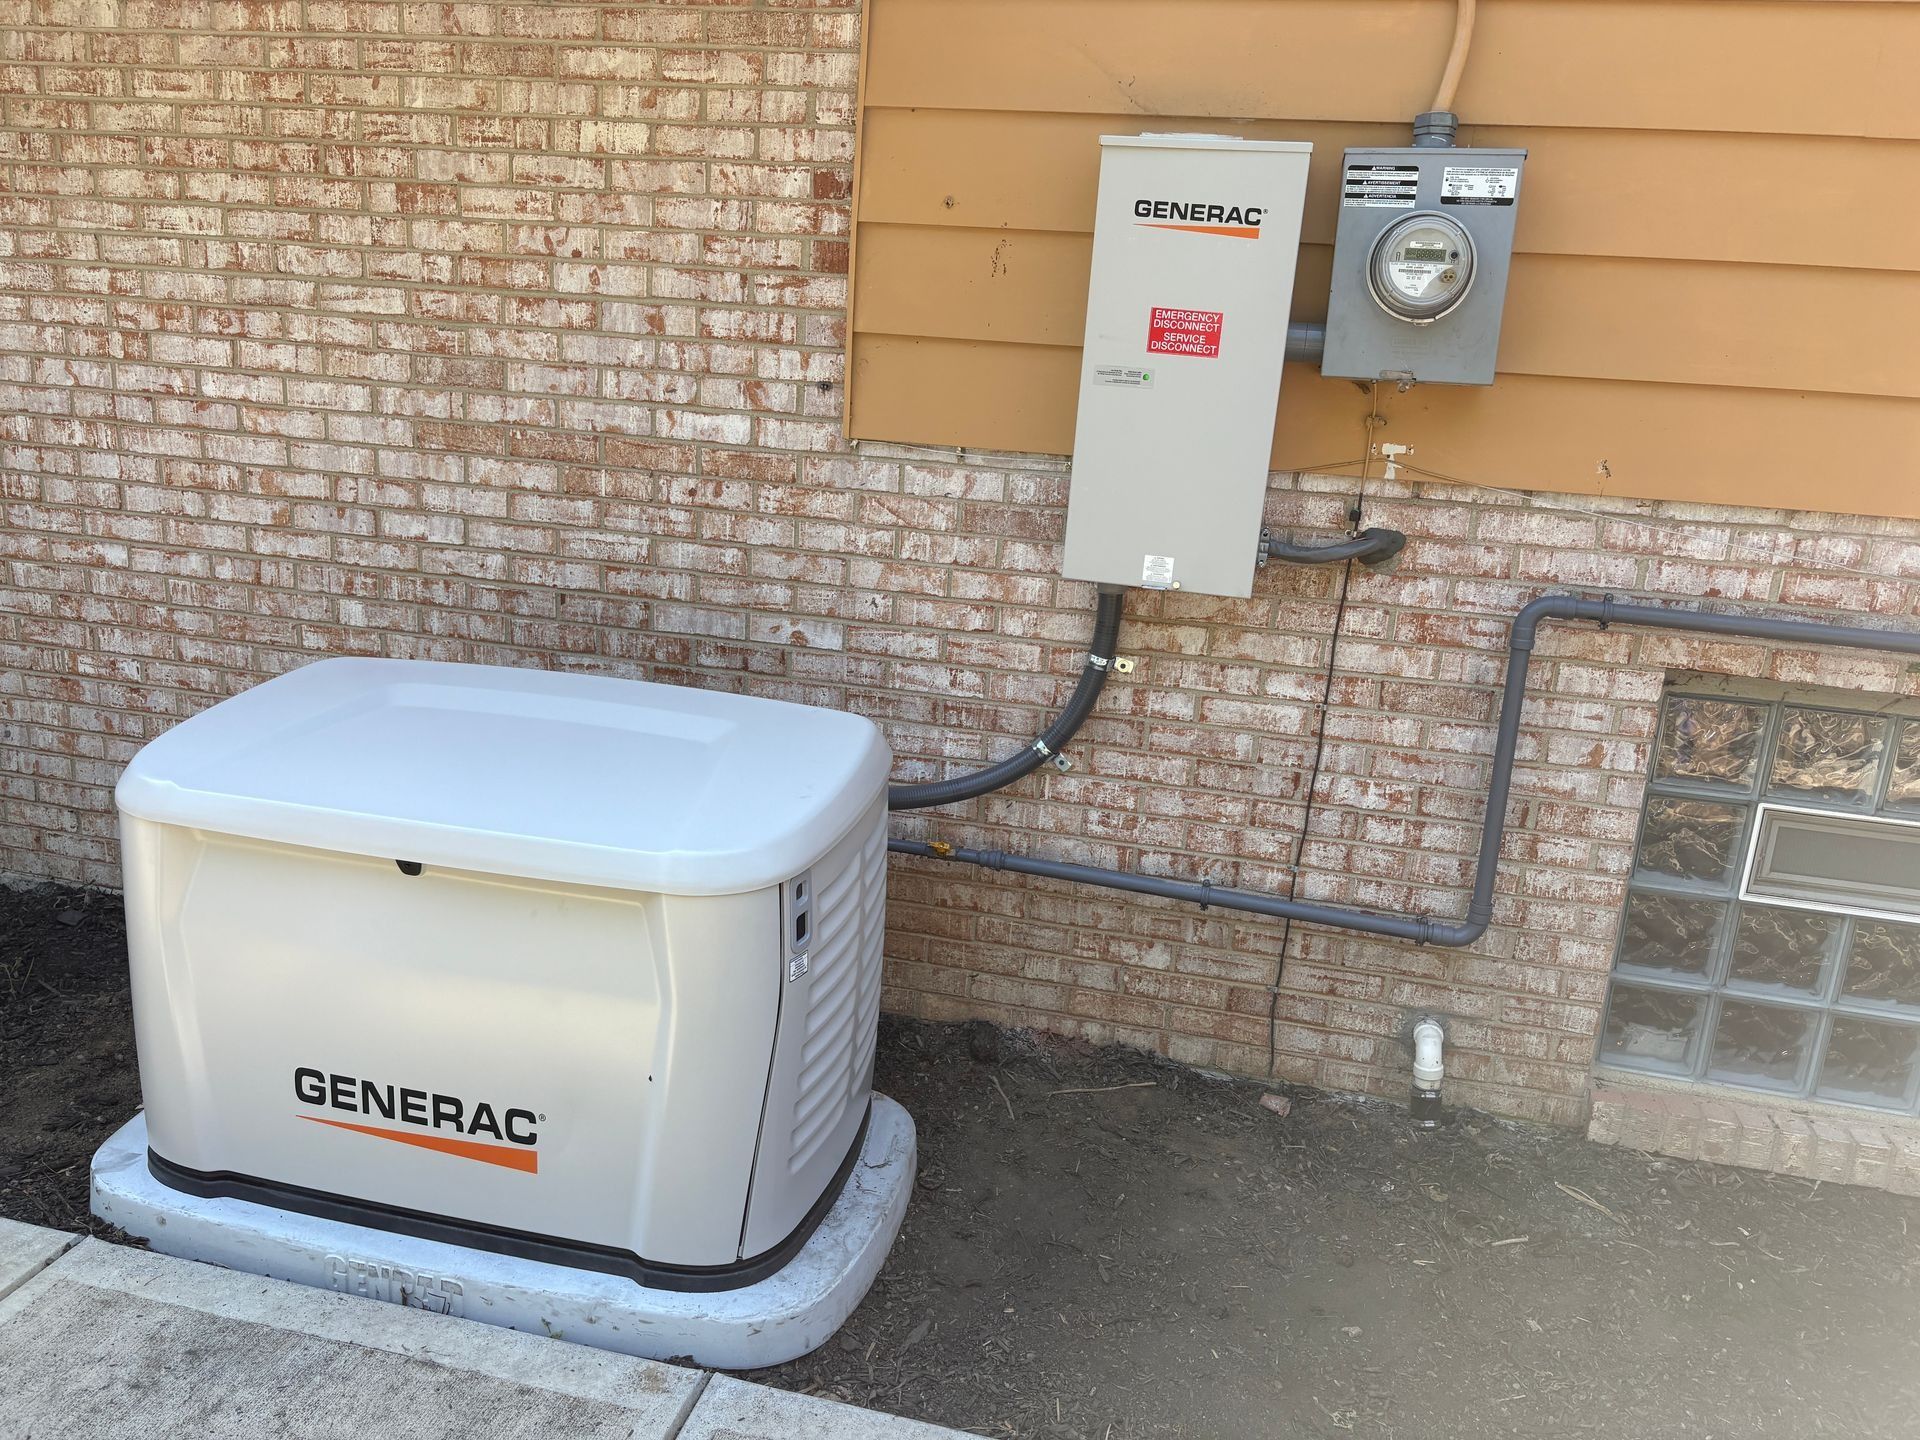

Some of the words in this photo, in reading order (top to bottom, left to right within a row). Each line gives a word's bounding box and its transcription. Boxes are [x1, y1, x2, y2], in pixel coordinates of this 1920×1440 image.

[1155, 309, 1220, 323] EMERGENCY
[1153, 318, 1220, 333] DISCONNECT
[1163, 331, 1206, 344] SERVICE
[1151, 340, 1217, 355] DISCONNECT
